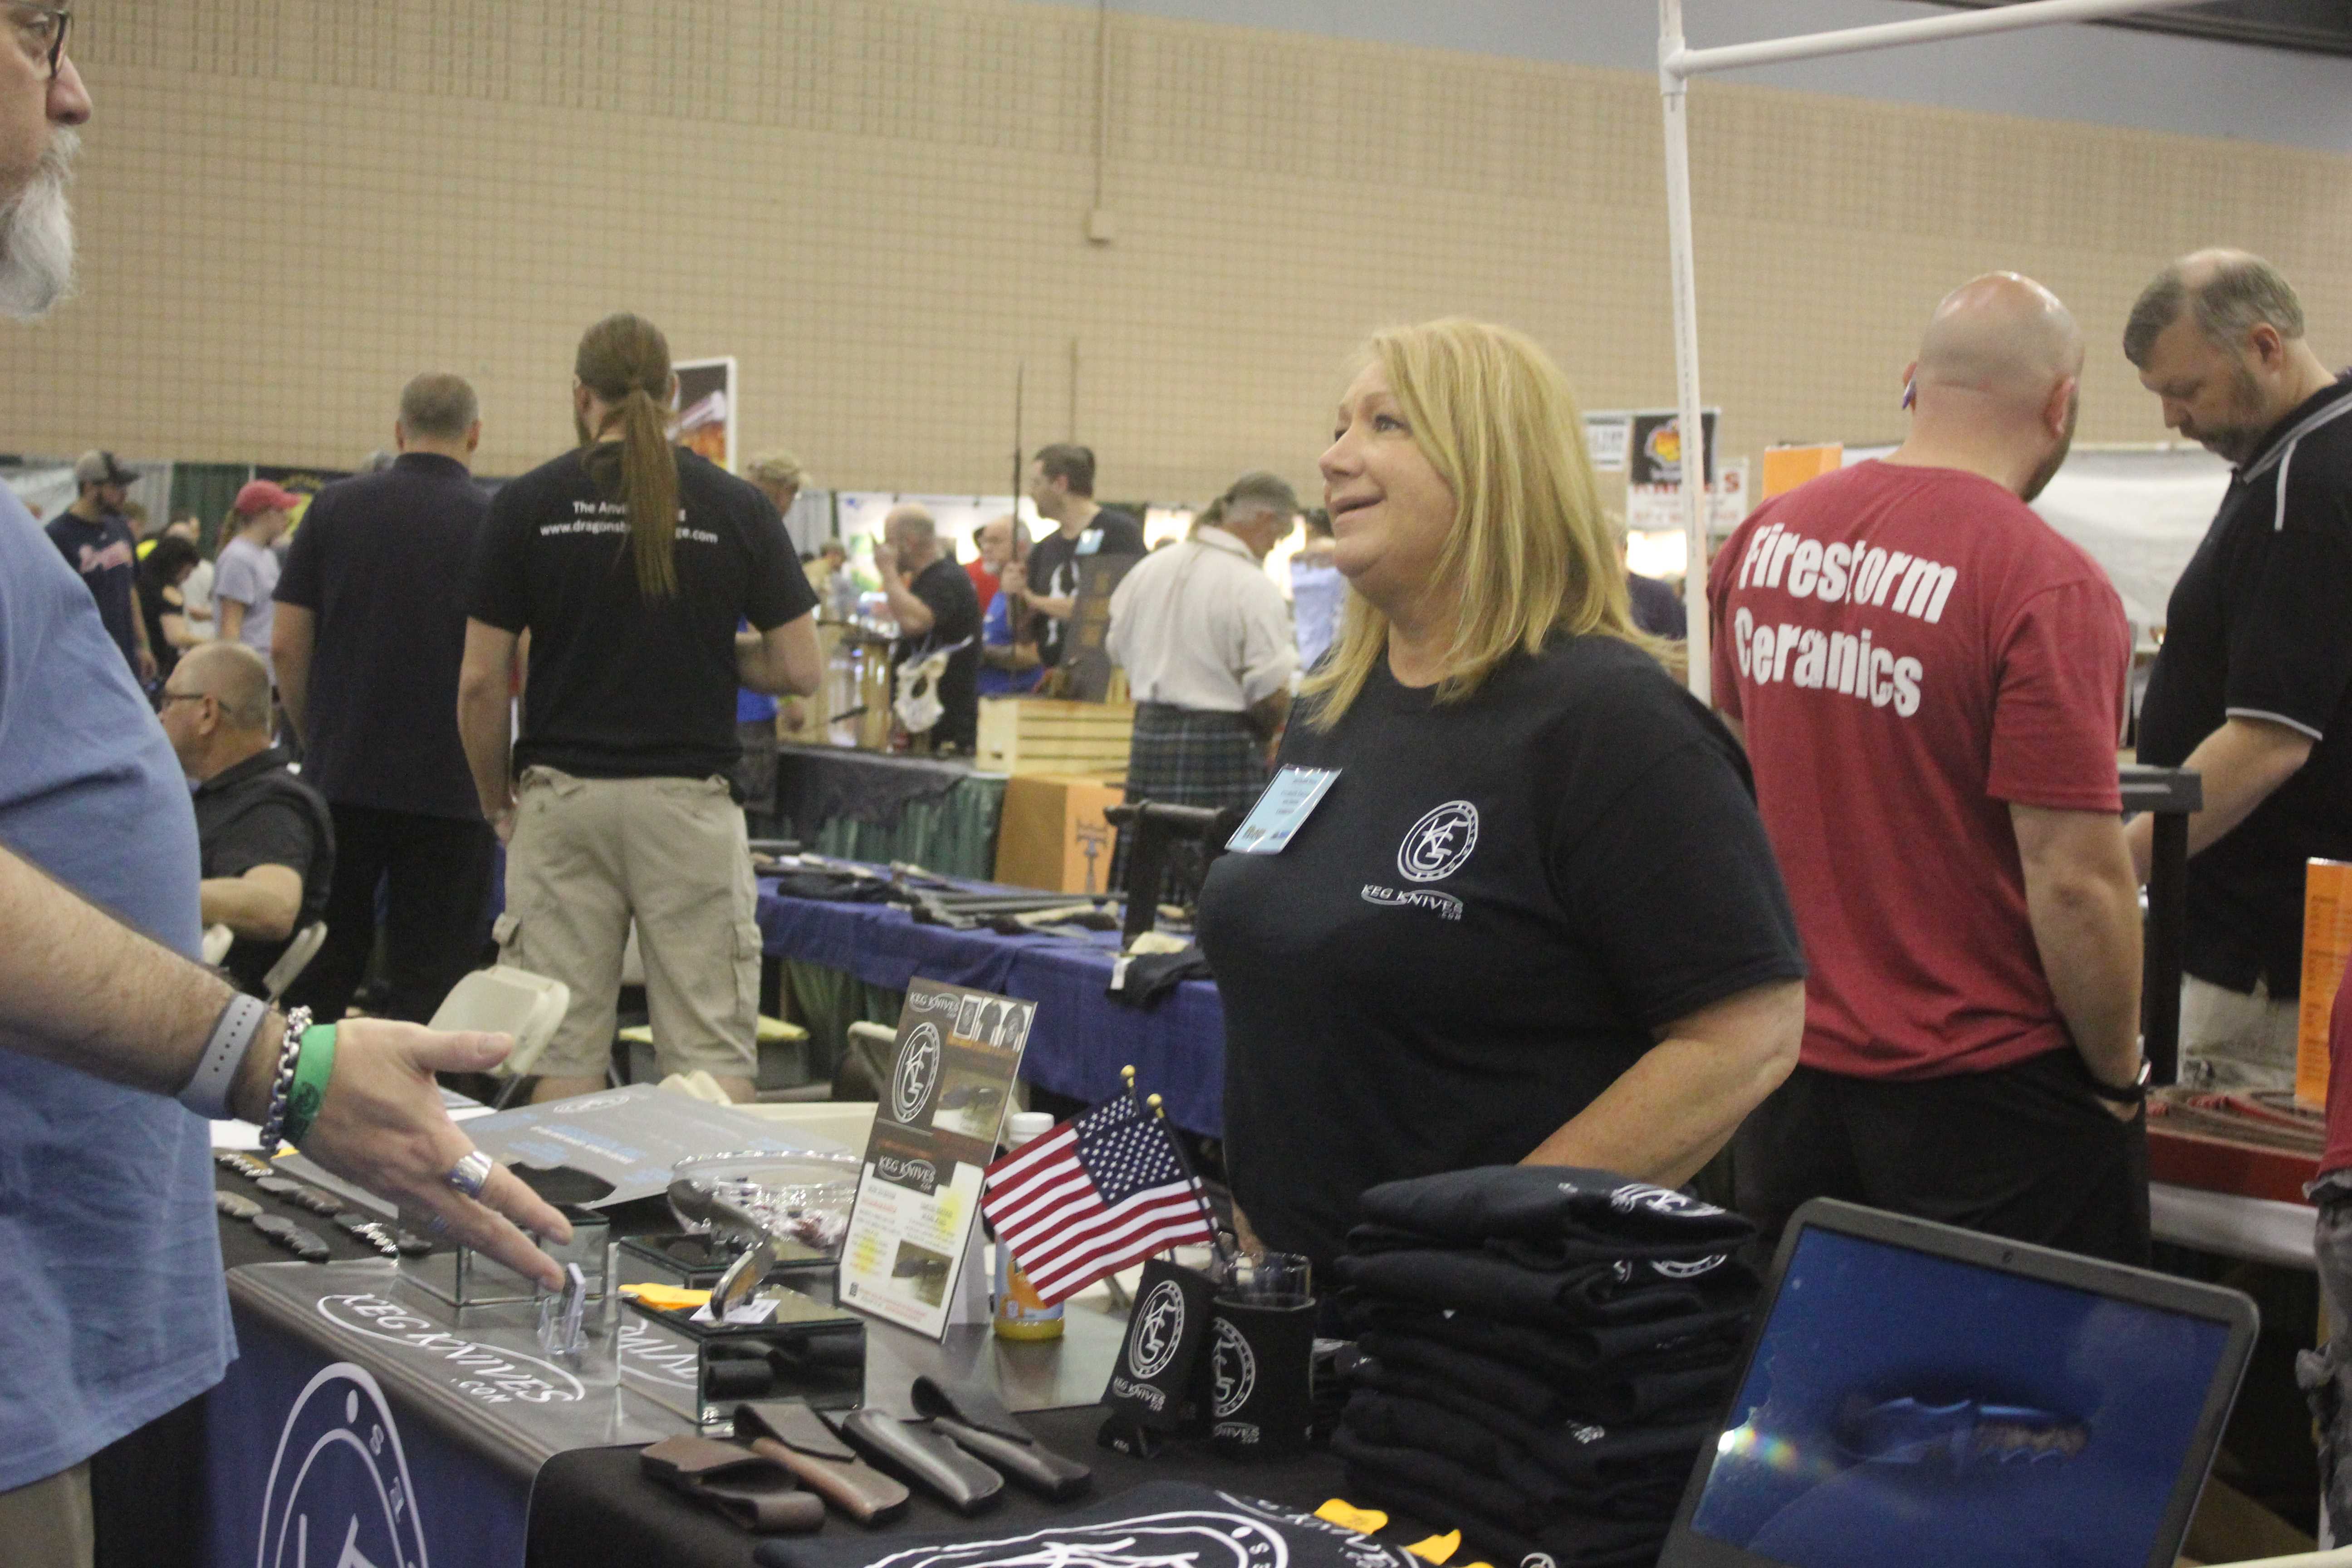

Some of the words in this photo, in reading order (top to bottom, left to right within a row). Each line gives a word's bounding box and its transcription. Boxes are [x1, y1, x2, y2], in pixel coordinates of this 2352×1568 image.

[573, 500, 596, 514] The
[1738, 523, 1958, 624] Firestorm
[342, 1293, 431, 1330] KEG
[405, 1331, 575, 1403] KNIVES
